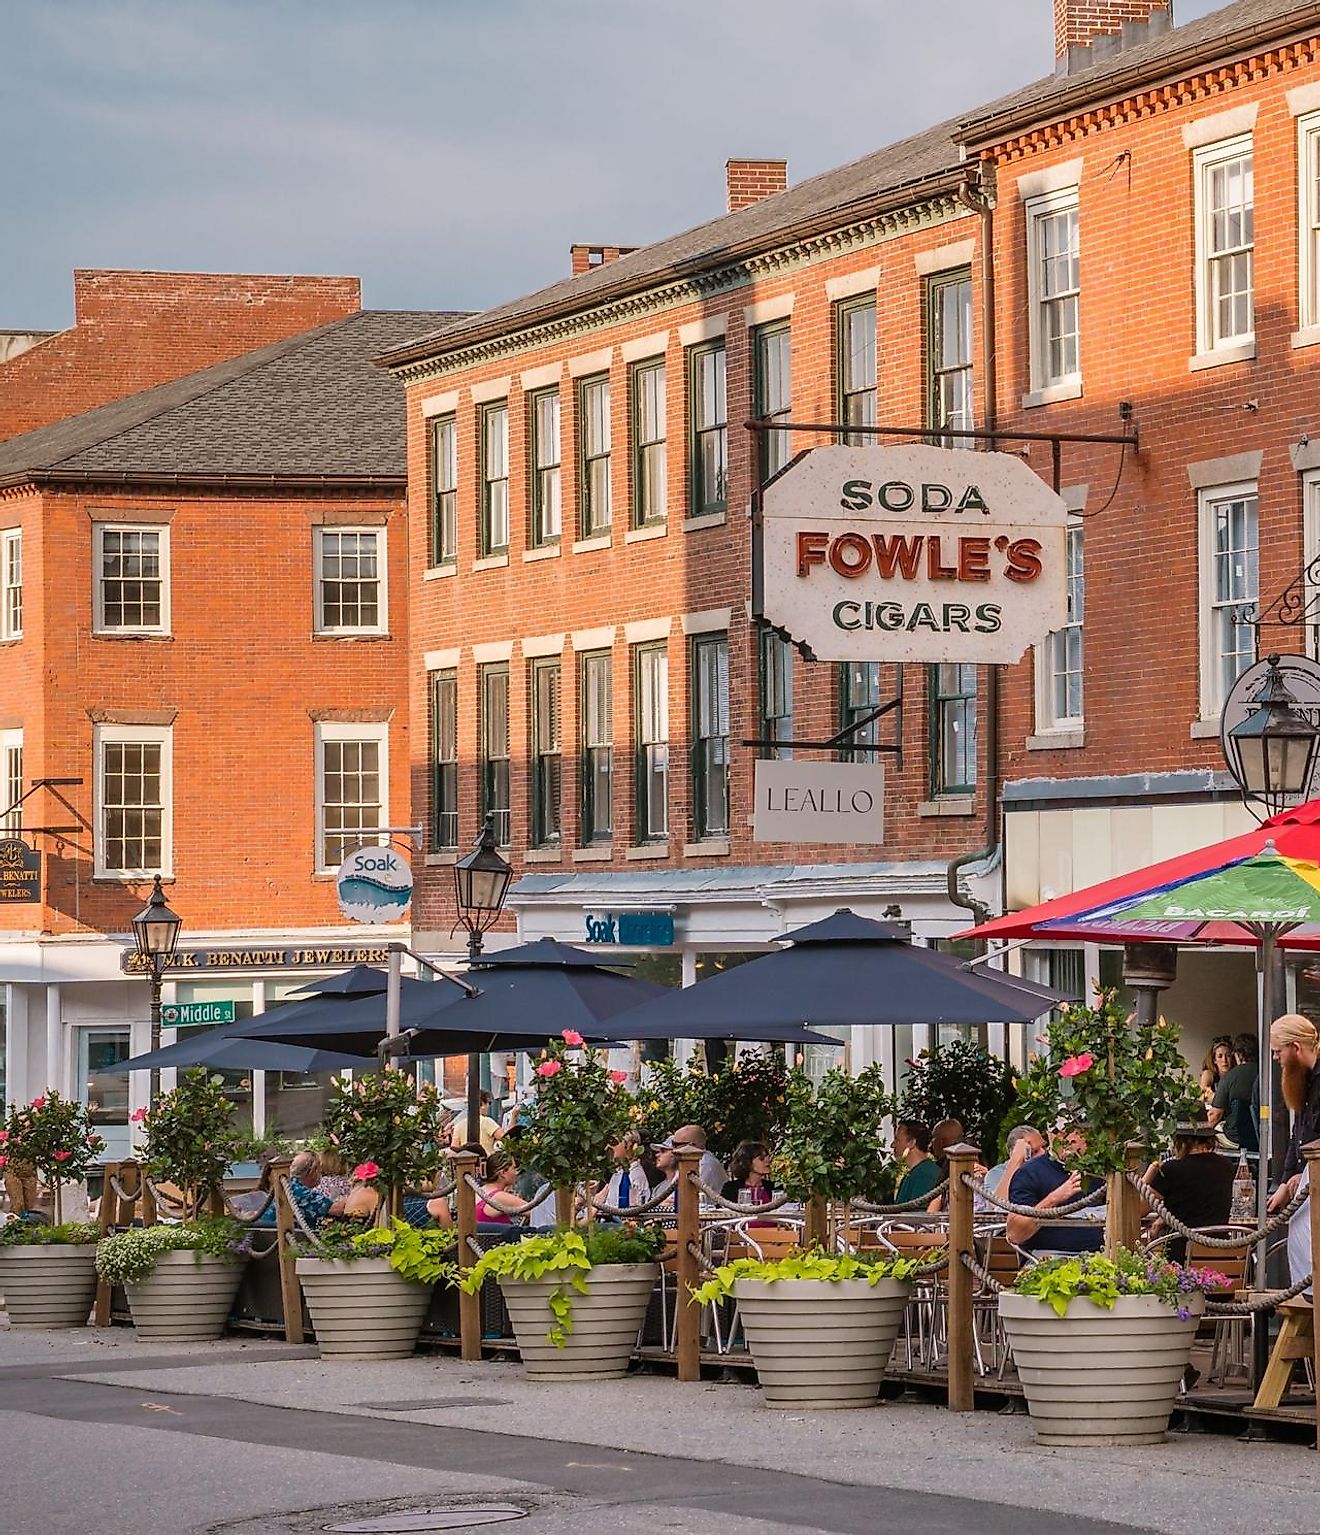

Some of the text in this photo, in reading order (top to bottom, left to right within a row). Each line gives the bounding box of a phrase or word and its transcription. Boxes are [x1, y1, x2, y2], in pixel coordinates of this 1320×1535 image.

[840, 479, 990, 515] SODA
[795, 531, 1043, 583] FOWLE'S
[832, 600, 1003, 633] CIGARS
[767, 787, 874, 814] LEALLO
[3, 870, 38, 880] BENATTI
[354, 854, 397, 872] Soak
[585, 912, 616, 943] Soak
[206, 949, 287, 967] BENATTI
[292, 948, 390, 964] JEWELERS
[180, 1003, 221, 1022] Middle
